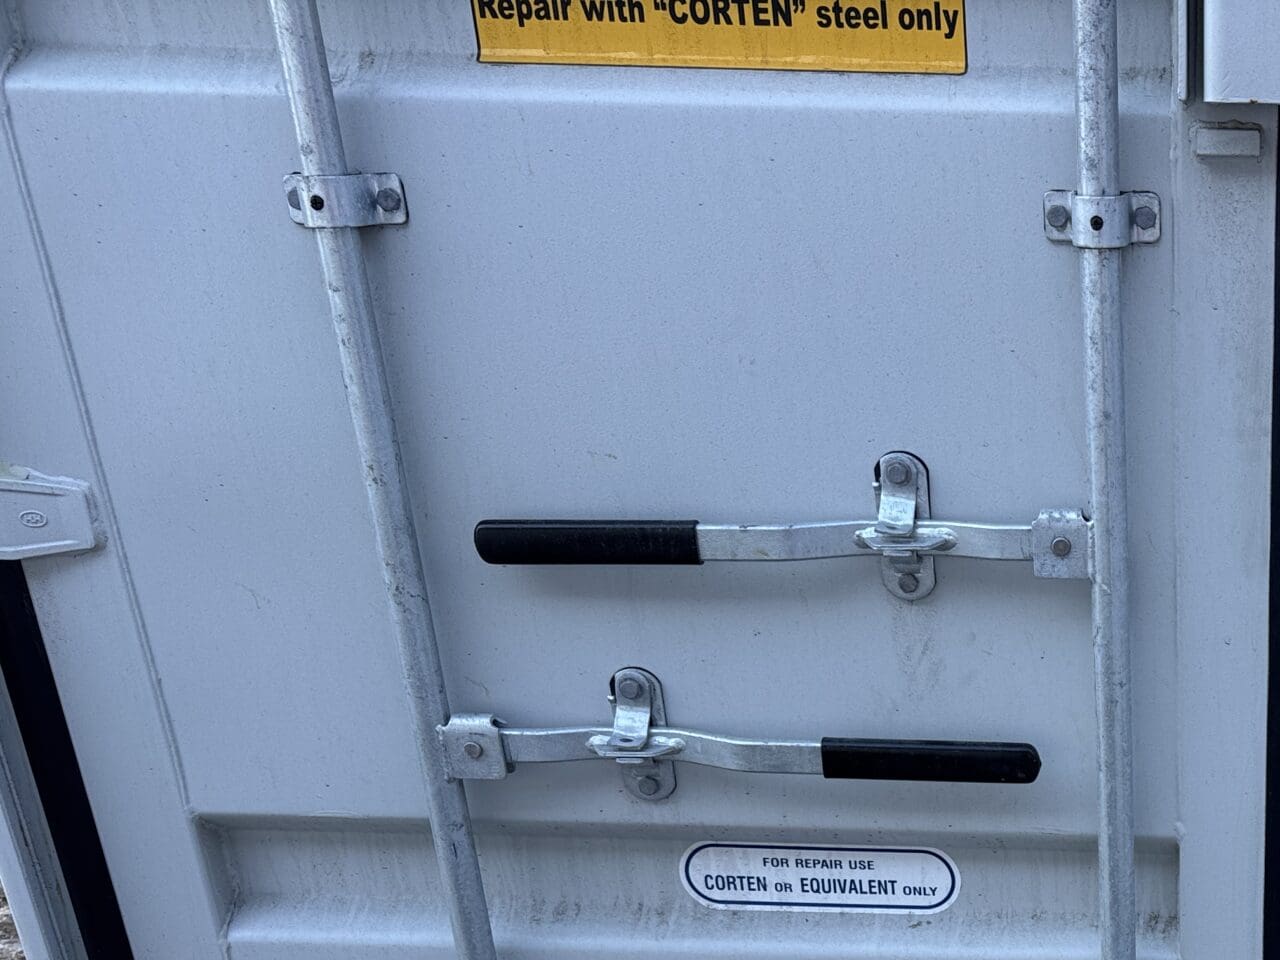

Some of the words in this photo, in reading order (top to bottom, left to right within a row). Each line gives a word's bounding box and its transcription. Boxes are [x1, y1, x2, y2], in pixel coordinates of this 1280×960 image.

[479, 0, 571, 27] Repair
[582, 0, 645, 22] with
[816, 0, 888, 29] steel
[899, 1, 959, 39] only
[762, 857, 790, 868] FOR
[795, 858, 843, 870] REPAIR
[848, 859, 875, 871] USE
[704, 874, 767, 892] CORTEN
[774, 881, 793, 893] OR
[800, 877, 897, 896] EQUIVALENT
[903, 885, 938, 897] ONLY
